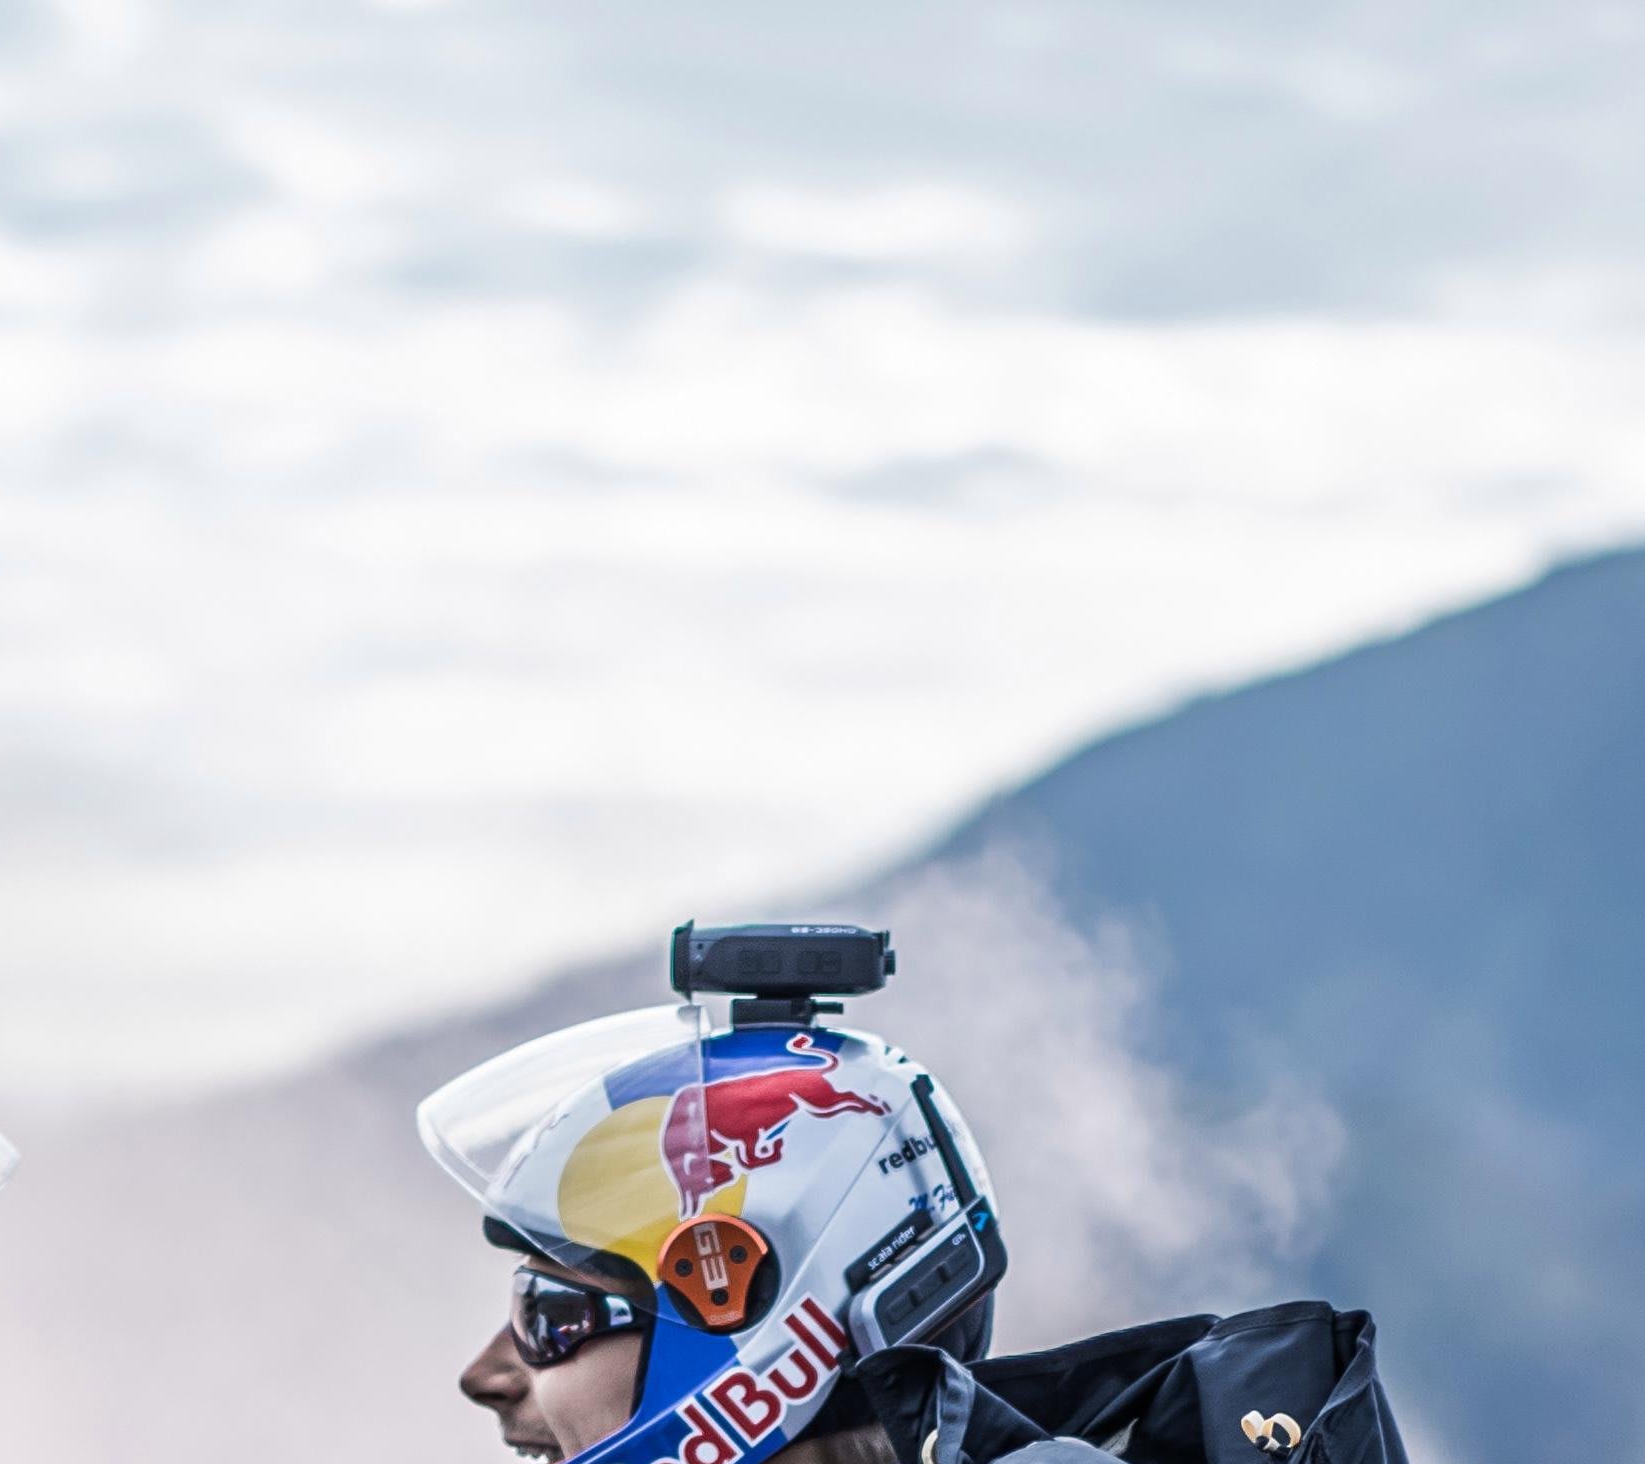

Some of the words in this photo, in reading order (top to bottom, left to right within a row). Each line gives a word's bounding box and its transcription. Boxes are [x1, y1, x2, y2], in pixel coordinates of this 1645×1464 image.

[867, 1244, 895, 1270] scala
[891, 1225, 917, 1250] rider
[710, 1297, 849, 1440] Bull
